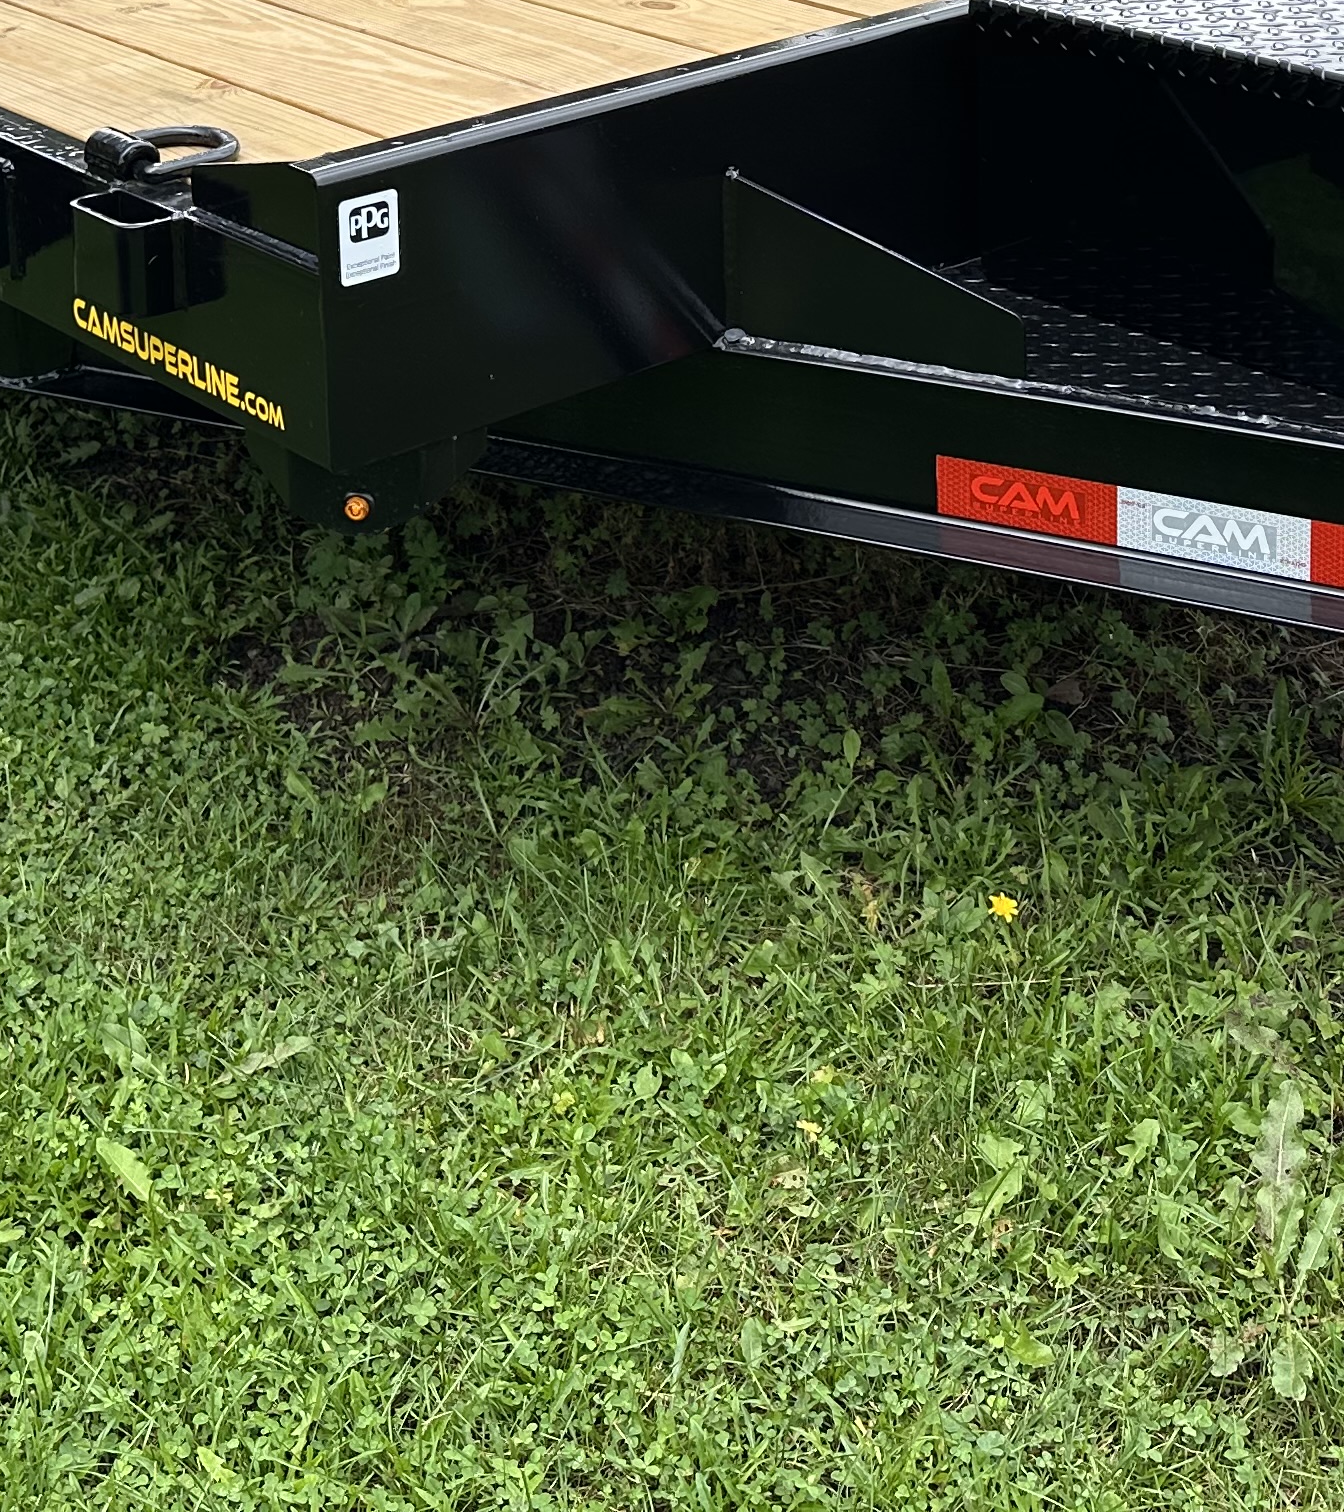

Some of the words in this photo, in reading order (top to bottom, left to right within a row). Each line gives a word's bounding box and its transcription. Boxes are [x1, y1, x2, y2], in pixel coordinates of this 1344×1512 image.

[350, 206, 389, 239] PPG
[73, 298, 285, 430] CAMSUPERLINE.COM
[971, 476, 1079, 519] CAM
[1153, 509, 1270, 554] CAM
[1155, 534, 1272, 562] SUPERLINE
